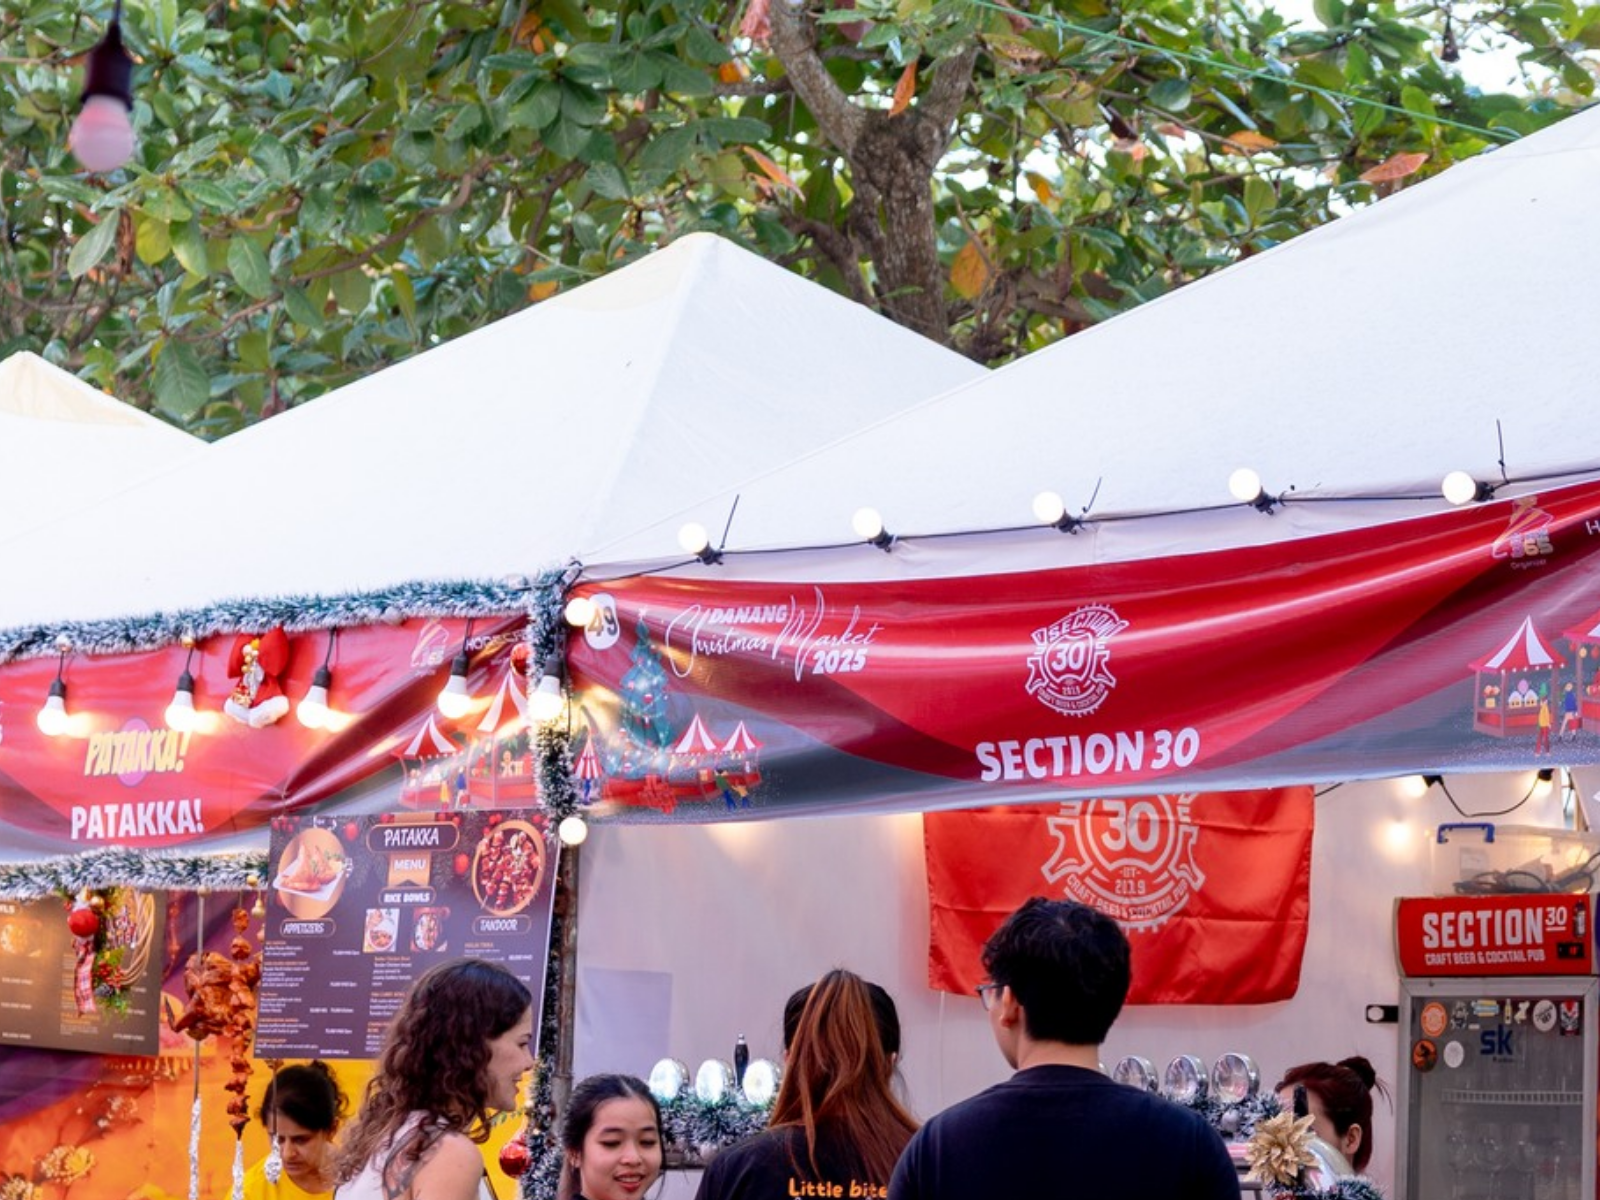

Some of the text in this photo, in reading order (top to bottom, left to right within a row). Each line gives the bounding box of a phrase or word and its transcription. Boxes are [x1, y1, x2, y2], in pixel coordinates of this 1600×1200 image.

[588, 605, 618, 637] 49
[709, 605, 787, 624] DANANG
[665, 585, 885, 682] Christmas Market
[812, 649, 868, 675] 2025
[1051, 641, 1085, 671] 30
[976, 727, 1200, 782] SECTION 30
[71, 798, 204, 840] PATAKKA!
[1101, 800, 1160, 852] 30
[384, 828, 439, 847] PATAKKA
[394, 860, 426, 871] MENU
[1422, 906, 1568, 949] SECTION 30
[1424, 952, 1452, 966] CRAFT
[1453, 951, 1477, 965] BEER
[1487, 950, 1527, 964] COCKTAIL
[1528, 949, 1546, 963] PUB
[788, 1178, 843, 1198] Little
